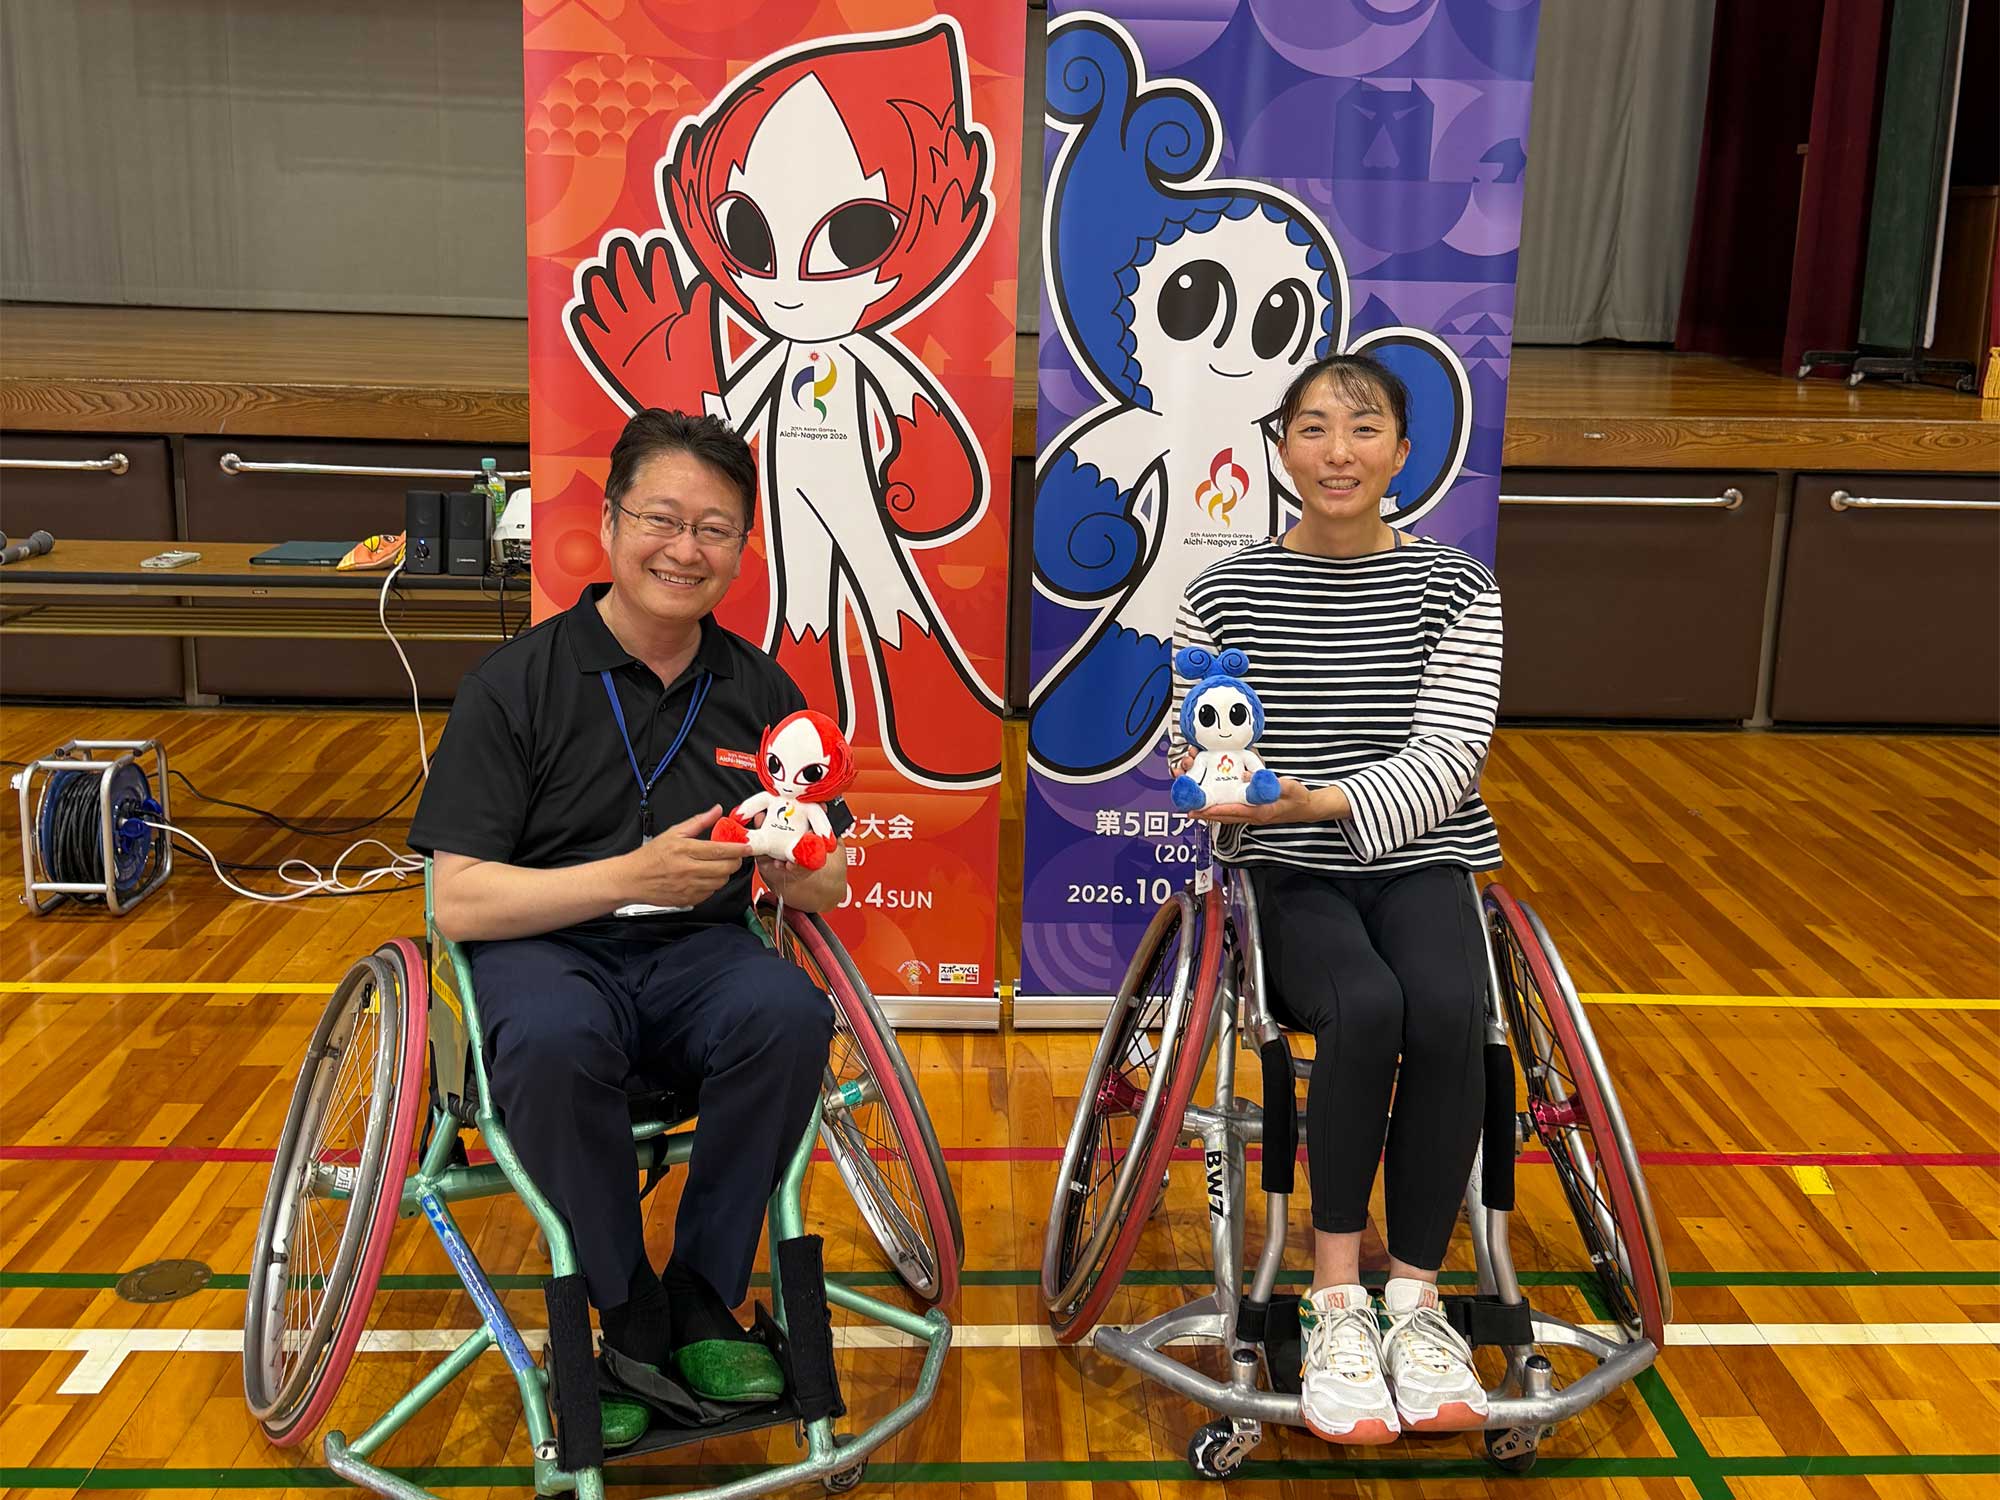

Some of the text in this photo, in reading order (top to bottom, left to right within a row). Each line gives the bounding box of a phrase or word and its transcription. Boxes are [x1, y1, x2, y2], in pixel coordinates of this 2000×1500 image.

[780, 432, 828, 440] Aichi-Nagoya
[1183, 538, 1237, 547] Aichi-Nagoya
[940, 965, 978, 974] スポーツくじ
